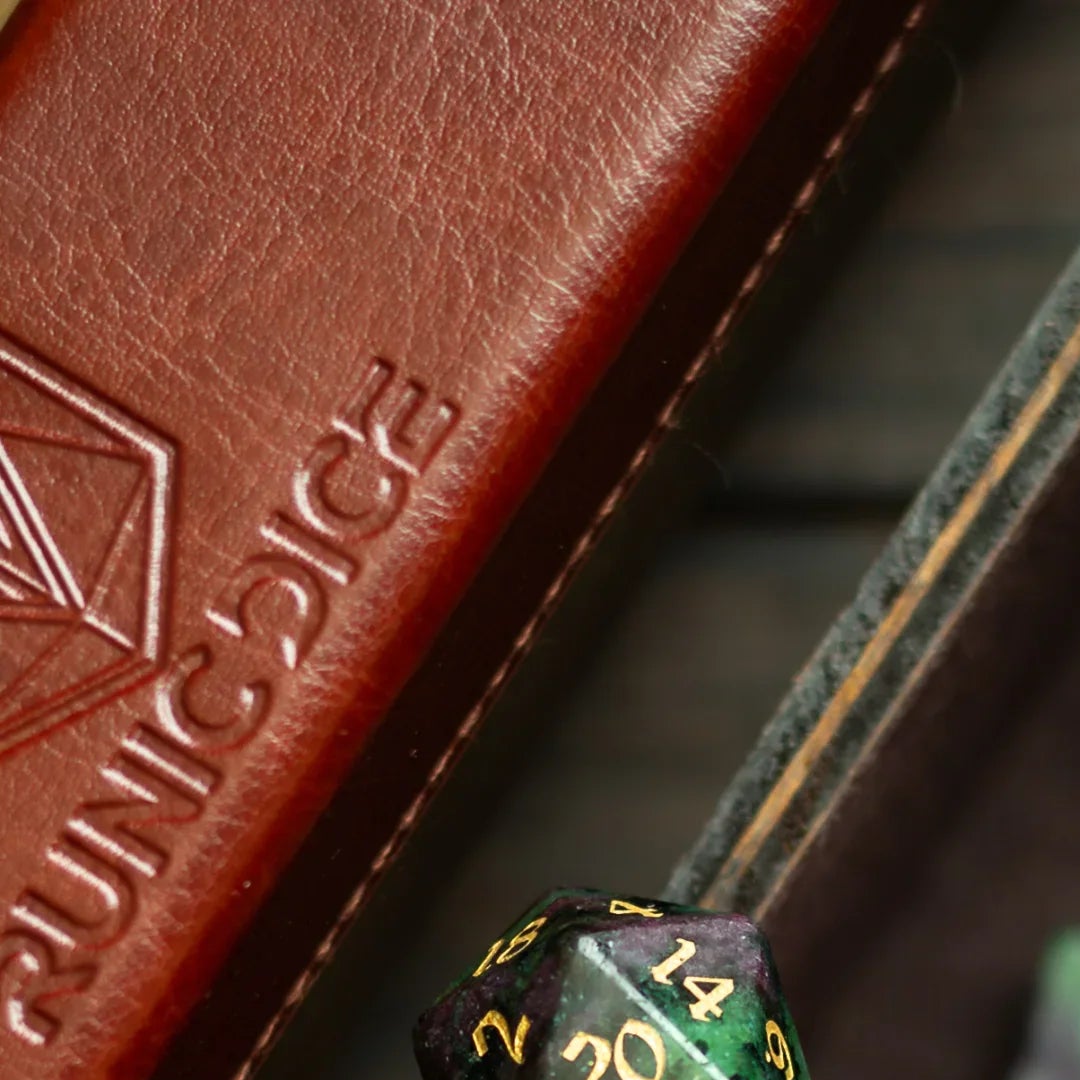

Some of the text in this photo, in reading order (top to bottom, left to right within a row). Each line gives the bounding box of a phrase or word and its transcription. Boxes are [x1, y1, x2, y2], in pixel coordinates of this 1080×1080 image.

[0, 356, 461, 1046] RUNIC DICE
[473, 917, 547, 977] 18
[649, 938, 734, 1021] 14
[472, 1010, 532, 1064] 2
